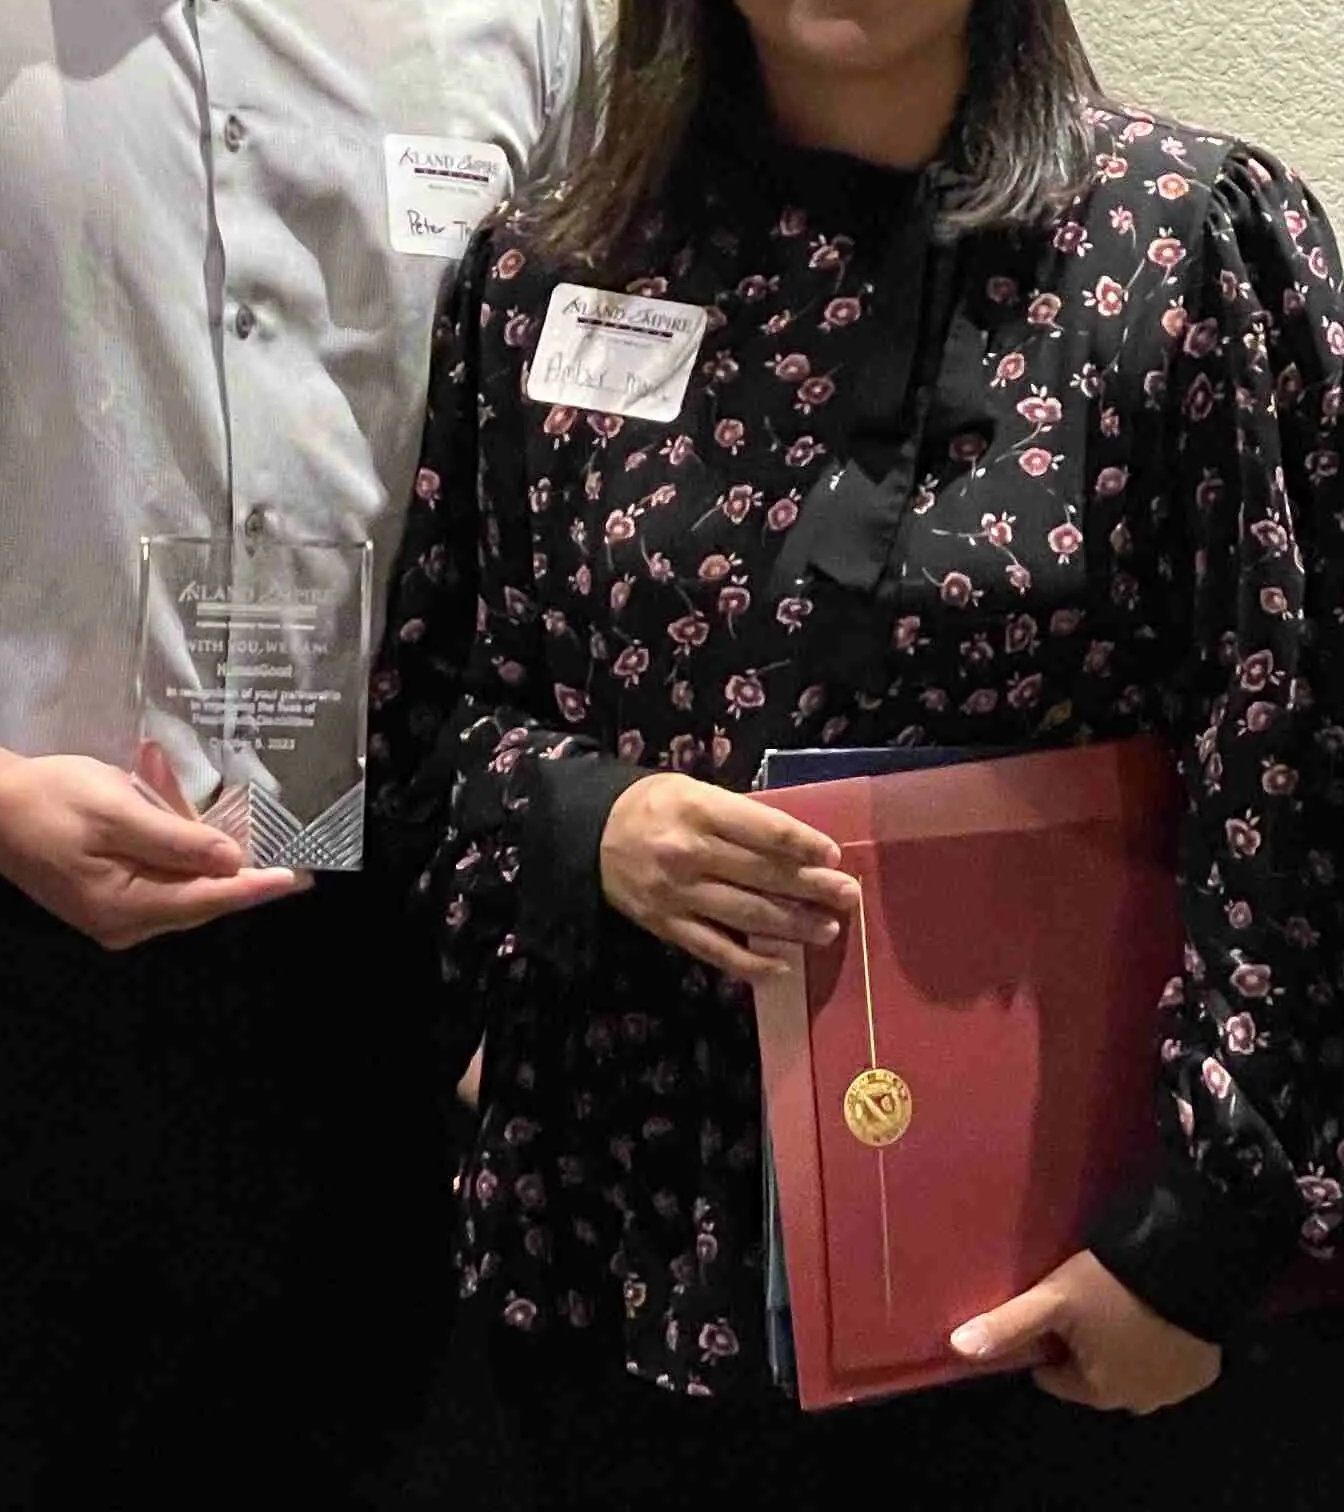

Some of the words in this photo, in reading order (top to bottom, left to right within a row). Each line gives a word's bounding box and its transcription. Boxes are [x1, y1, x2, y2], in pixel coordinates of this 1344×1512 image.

[407, 209, 445, 236] Peter
[188, 639, 224, 653] WITH
[266, 639, 288, 653] WE
